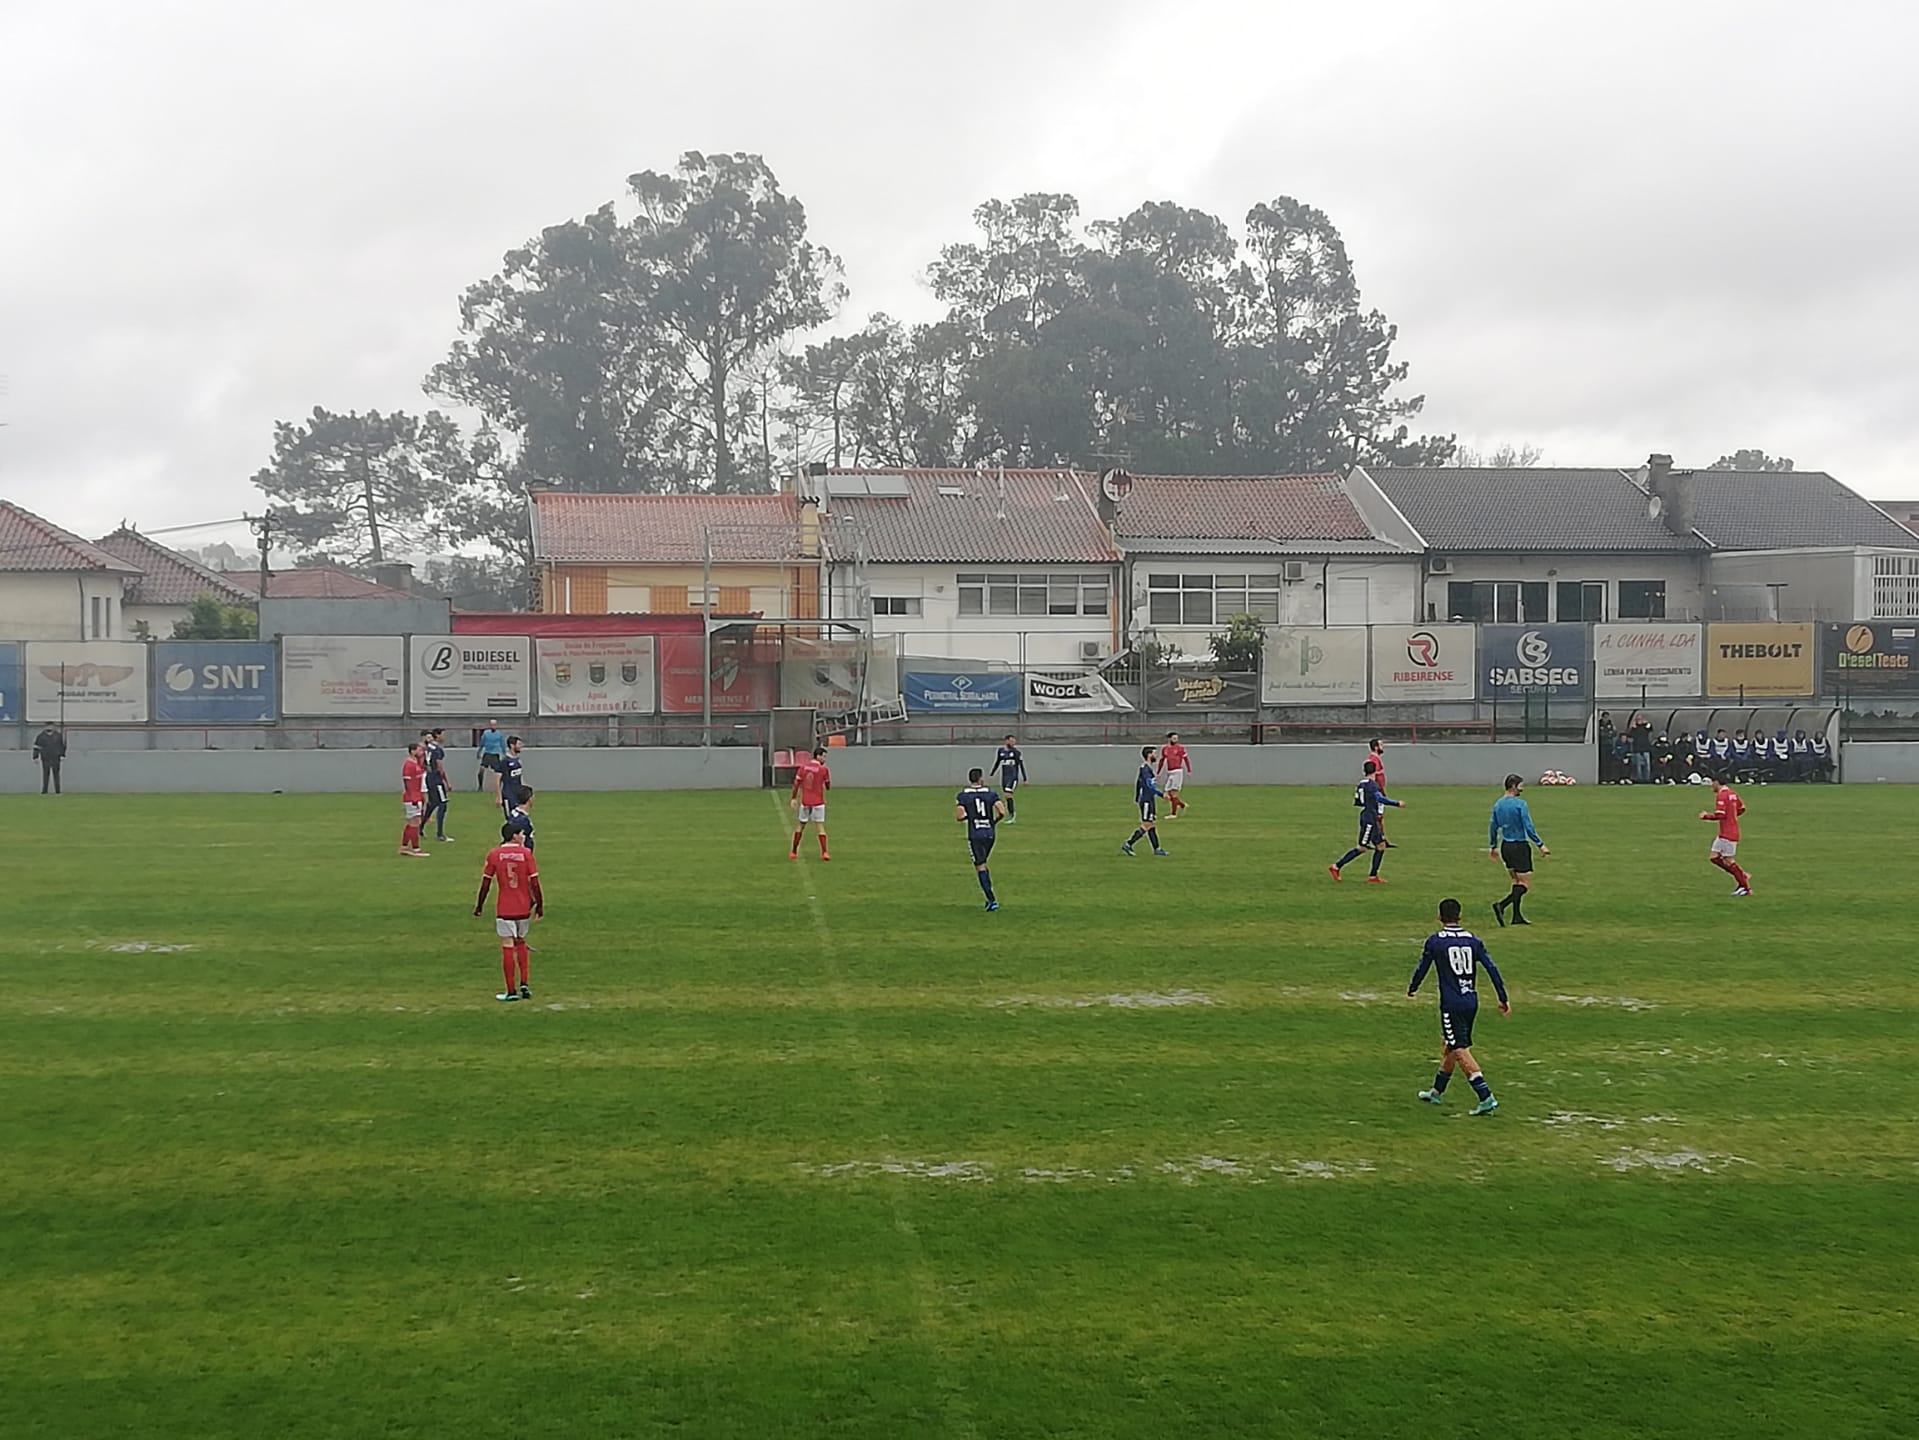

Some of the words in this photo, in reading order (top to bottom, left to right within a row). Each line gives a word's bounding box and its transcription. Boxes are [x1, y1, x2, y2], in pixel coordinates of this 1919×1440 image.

[1670, 633, 1696, 647] LDA
[463, 651, 520, 662] BIDIESEL
[1720, 644, 1802, 658] THEBOLT
[203, 665, 266, 689] SNT
[1393, 671, 1454, 682] RIBEIRENSE
[1490, 668, 1578, 685] SABSEG
[975, 798, 985, 817] 4
[507, 862, 518, 889] 5
